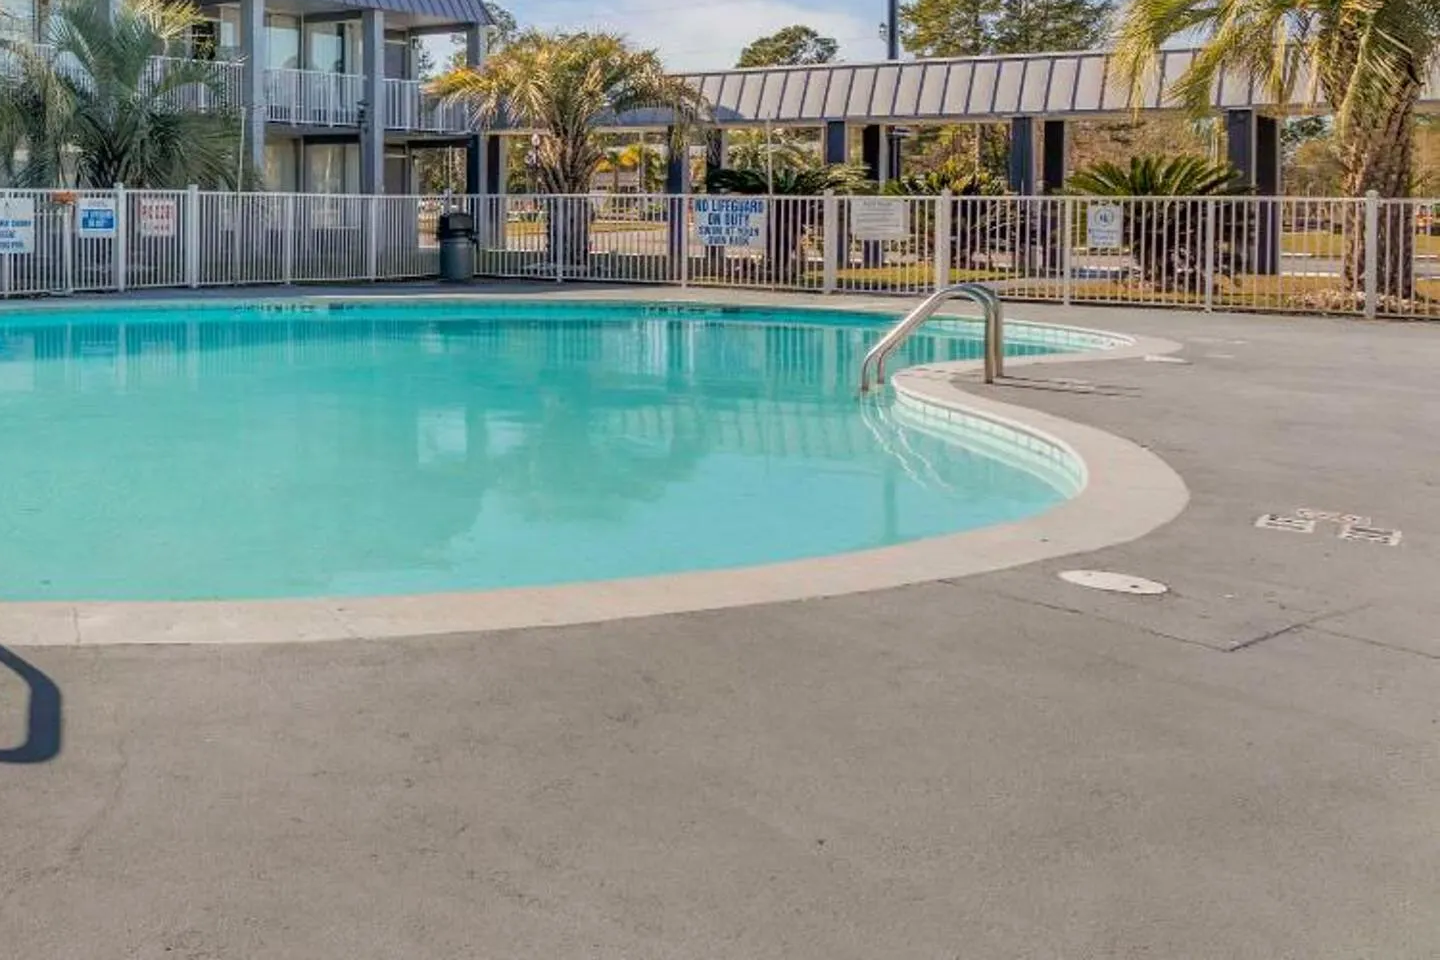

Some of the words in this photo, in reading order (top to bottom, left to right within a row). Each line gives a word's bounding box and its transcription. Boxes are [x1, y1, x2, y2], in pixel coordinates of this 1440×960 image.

[694, 198, 709, 212] NO
[711, 198, 765, 213] LIFEGUARD
[724, 212, 750, 226] DUTY
